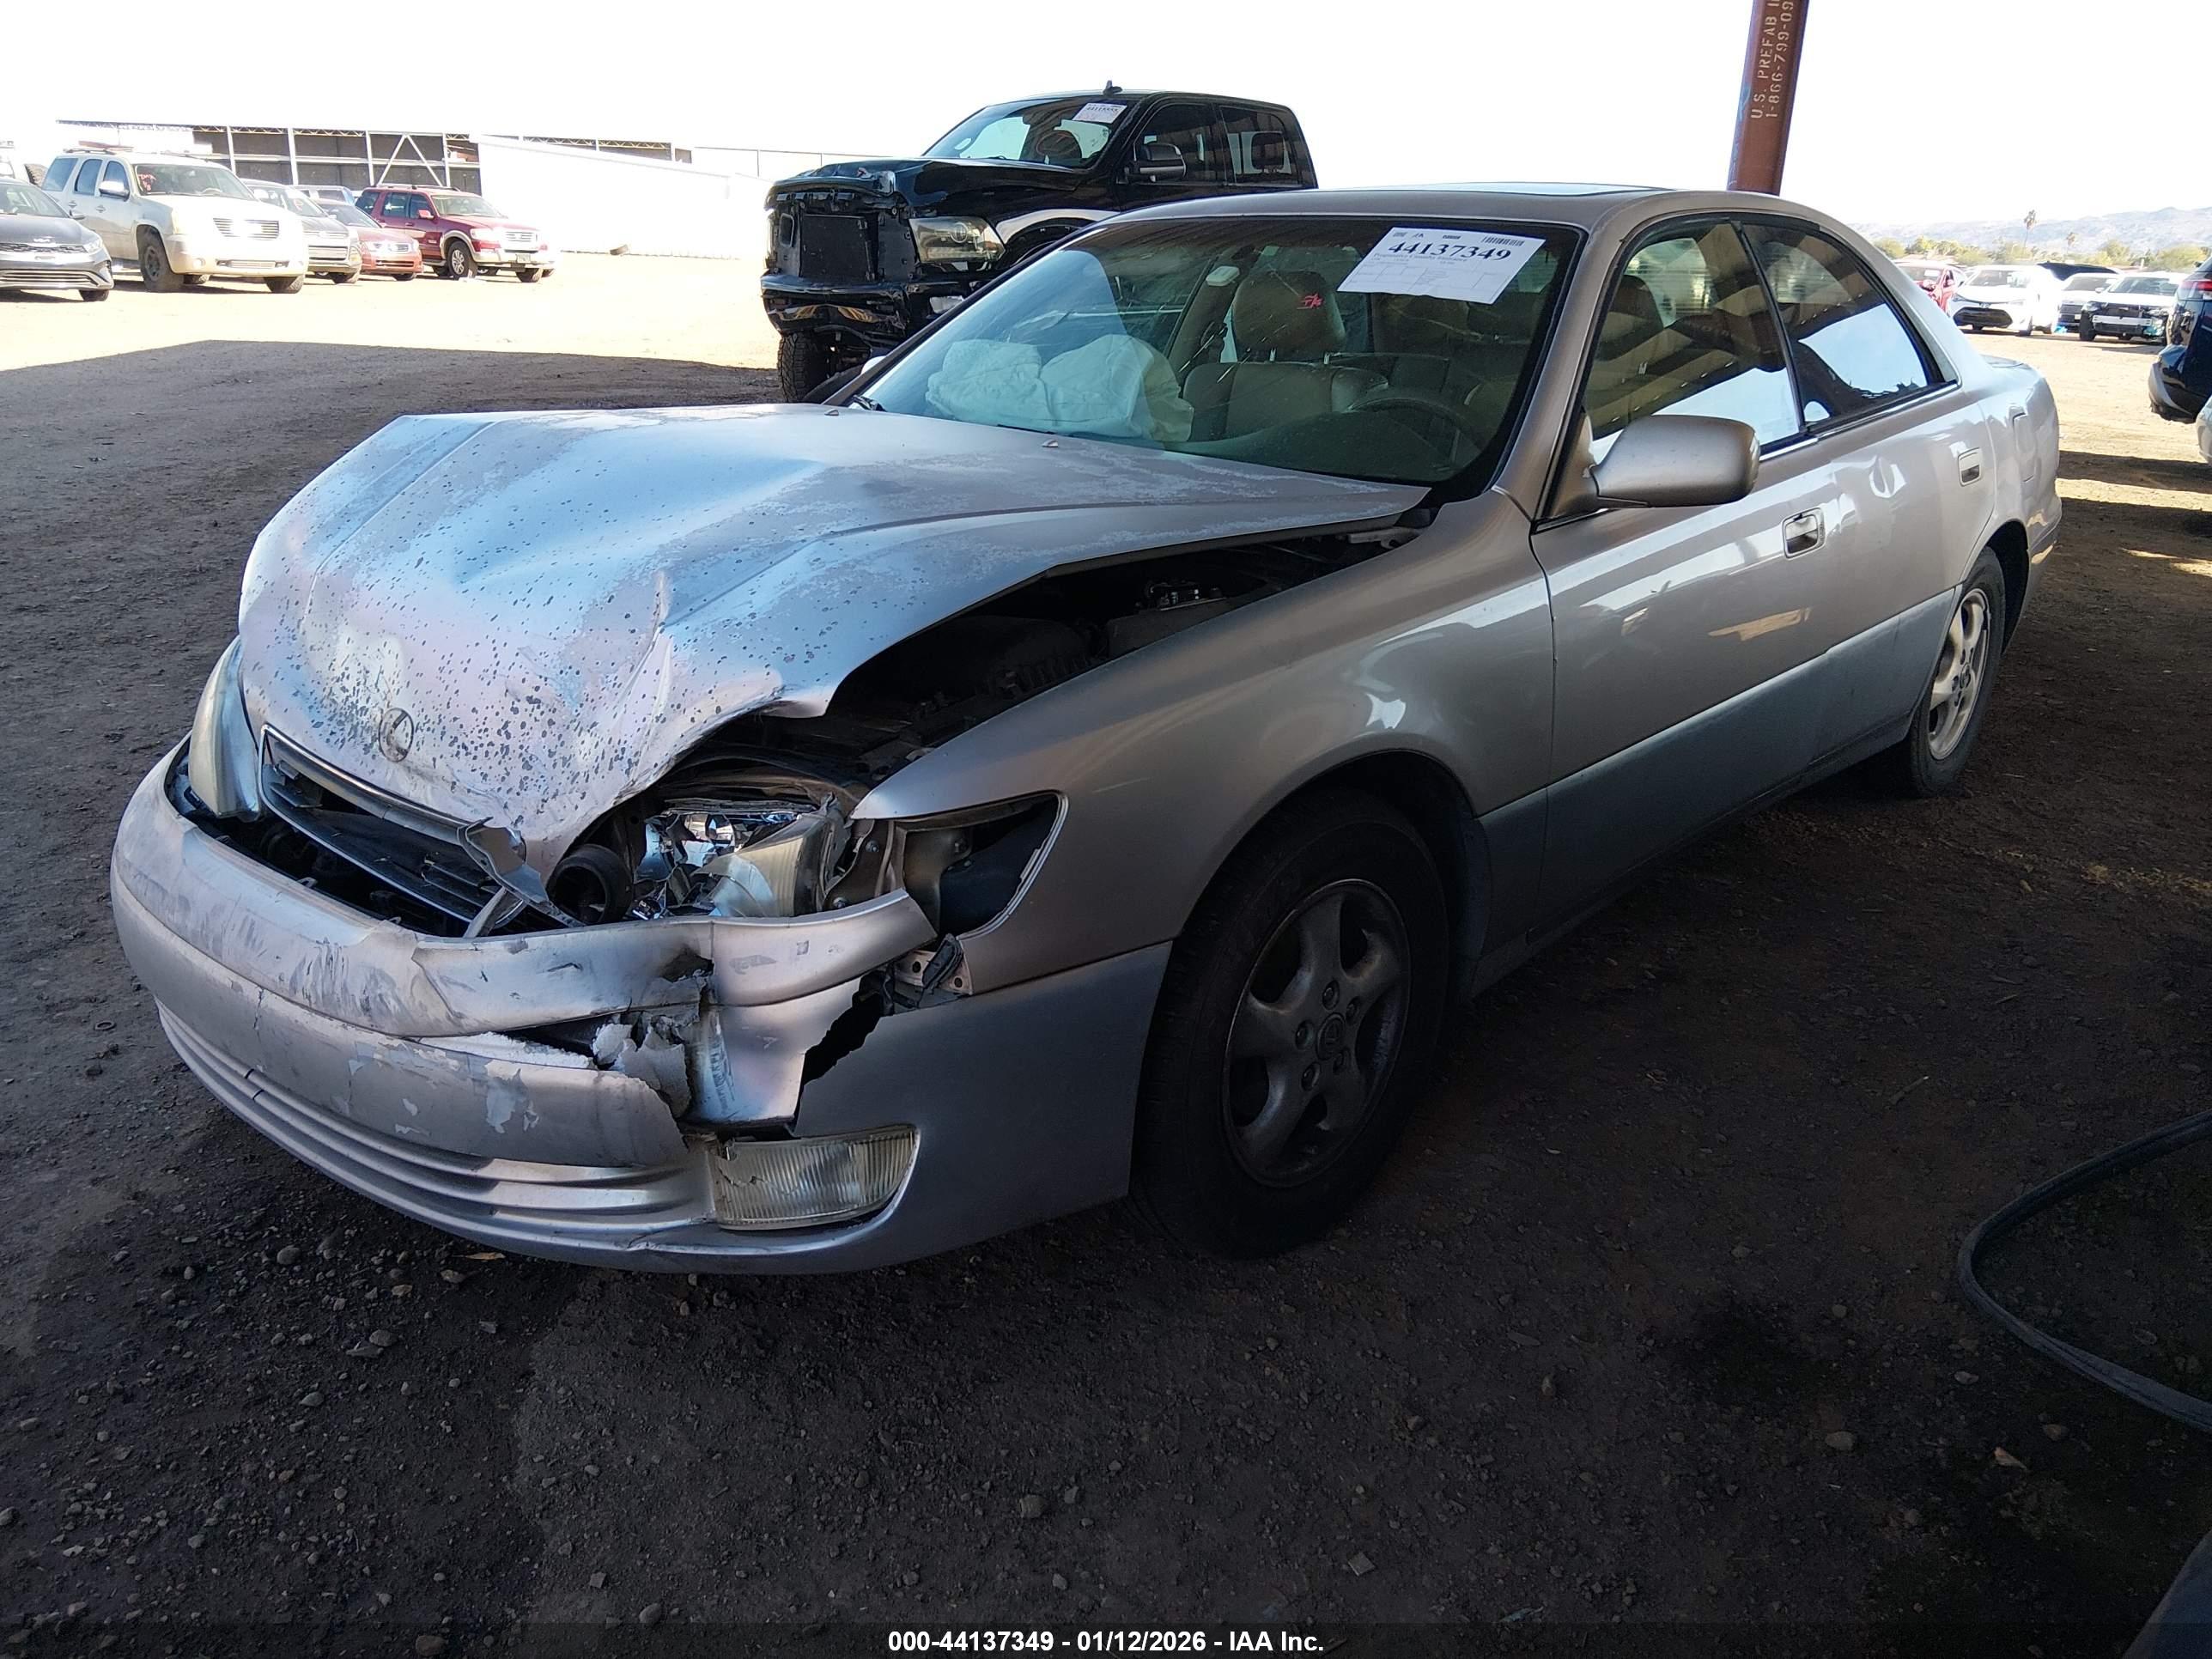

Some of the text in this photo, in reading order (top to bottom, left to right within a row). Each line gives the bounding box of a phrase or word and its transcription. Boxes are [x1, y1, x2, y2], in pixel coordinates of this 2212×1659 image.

[1757, 16, 1778, 79] PREFAB
[1750, 88, 1767, 118] U.S.
[1389, 241, 1511, 261] 44137349
